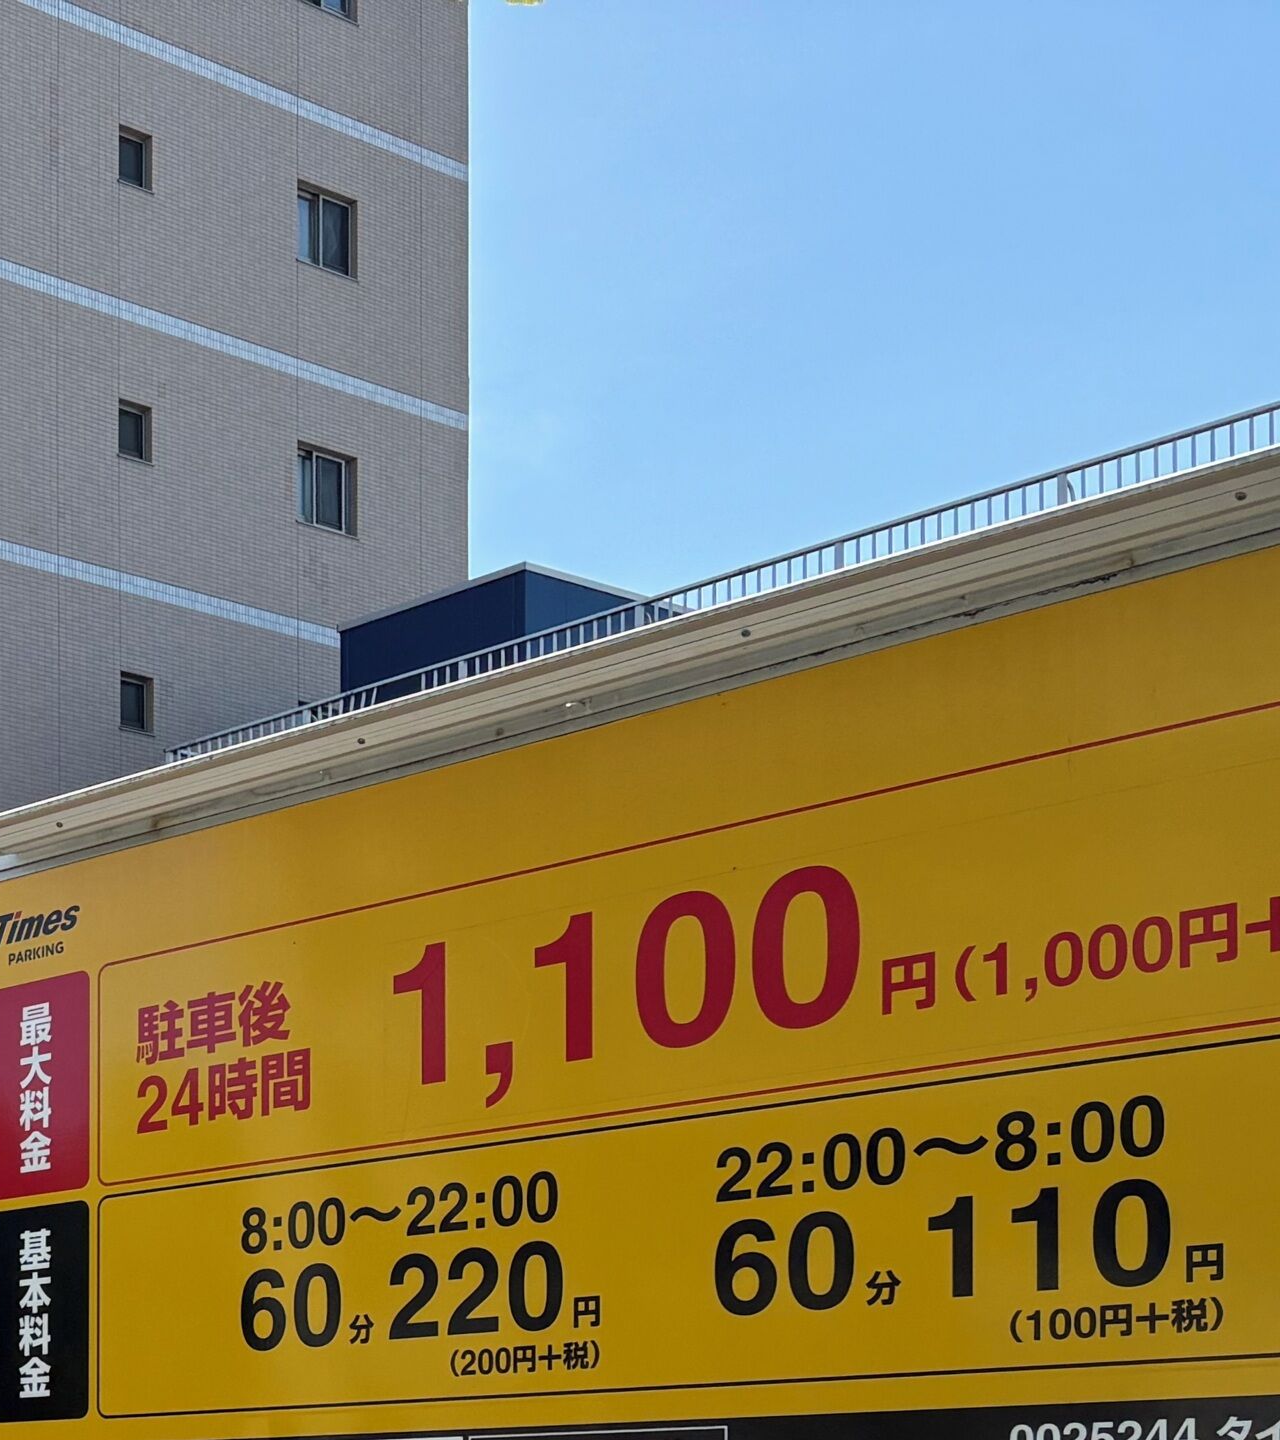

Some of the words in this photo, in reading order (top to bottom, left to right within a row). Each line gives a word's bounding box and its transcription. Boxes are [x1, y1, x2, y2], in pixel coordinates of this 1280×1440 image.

[8, 941, 64, 966] PARKING
[136, 980, 292, 1065] 駐車後
[18, 1002, 52, 1174] 最大料金
[136, 1047, 312, 1134] 24時間
[18, 1229, 52, 1399] 基本料金
